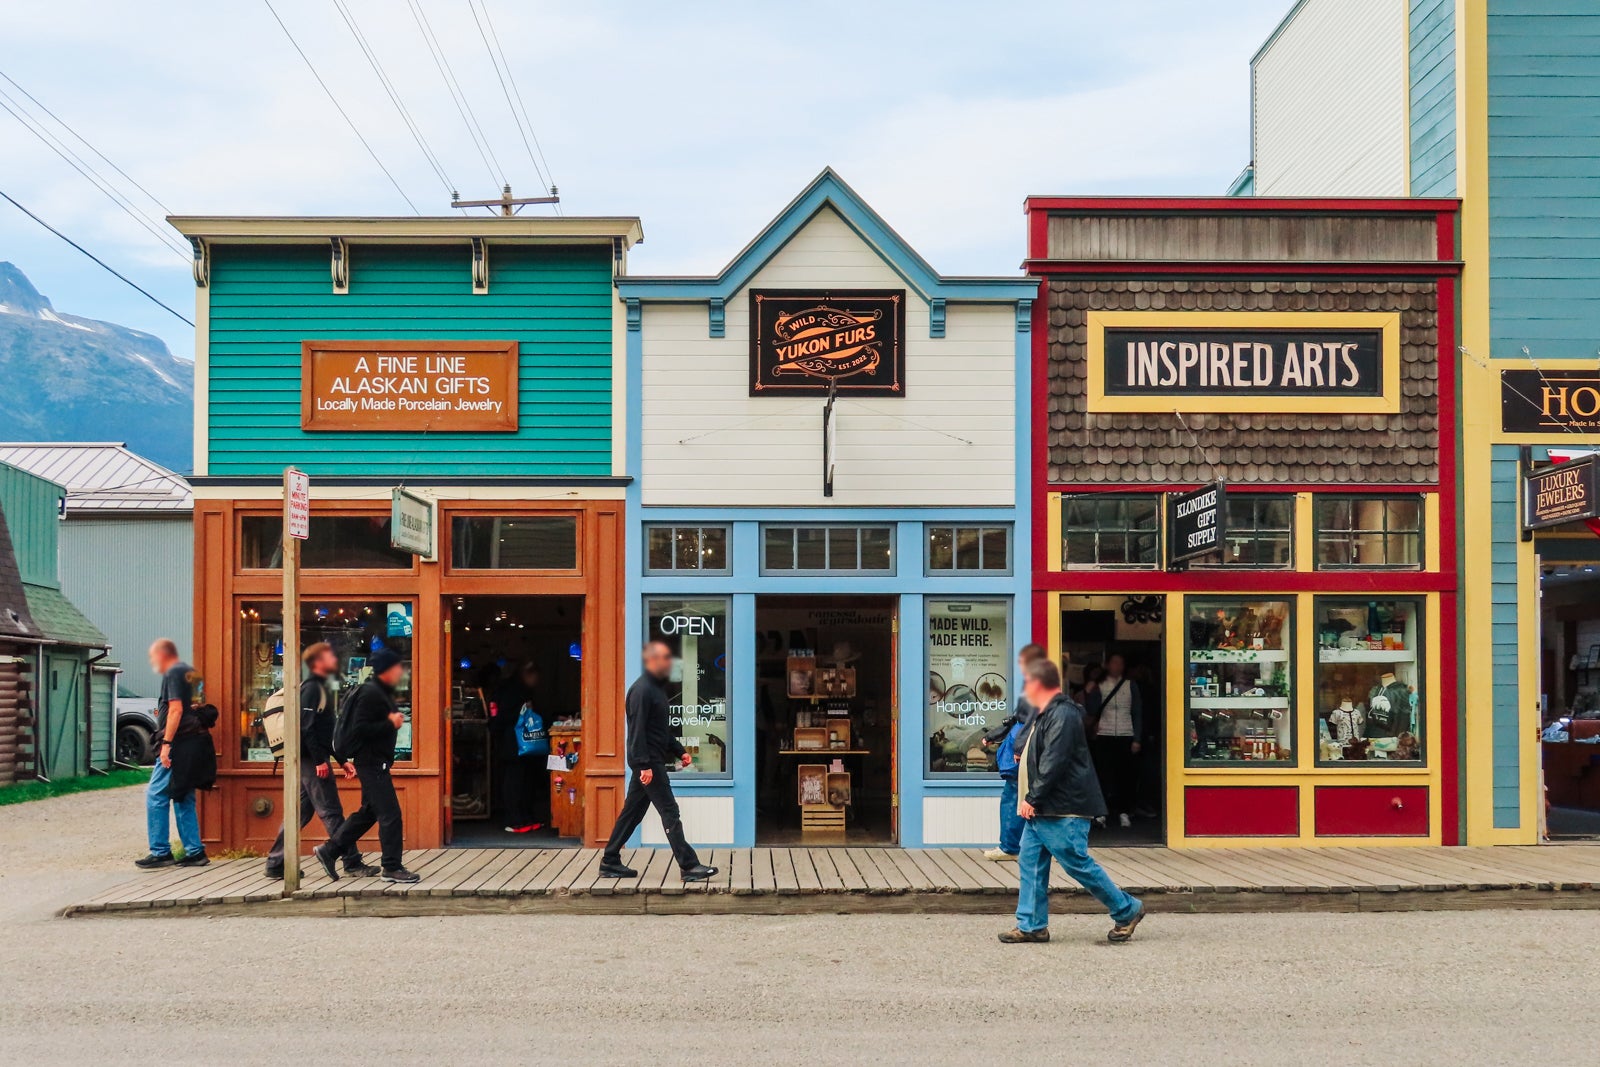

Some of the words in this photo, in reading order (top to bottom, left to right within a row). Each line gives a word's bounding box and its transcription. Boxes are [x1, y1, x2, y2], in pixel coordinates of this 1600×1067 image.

[788, 315, 816, 331] WILD
[775, 336, 830, 362] YUKON
[835, 325, 876, 348] FURS
[354, 357, 370, 374] A
[378, 357, 418, 374] FINE
[425, 357, 466, 374] LINE
[838, 363, 852, 371] EST.
[852, 354, 868, 367] 2022
[1127, 341, 1273, 387] INSPIRED
[1281, 341, 1360, 388] ARTS
[330, 377, 428, 394] ALASKAN
[435, 377, 490, 394] GIFTS
[317, 397, 359, 413] Locally
[361, 398, 396, 411] Made
[398, 397, 451, 411] Porcelain
[454, 398, 502, 413] Jewelry
[1540, 469, 1580, 493] LUXURY
[290, 500, 308, 512] PARKING
[1176, 490, 1217, 519] KLONDIKE
[1536, 483, 1585, 512] JEWELERS
[1197, 508, 1217, 528] GIFT
[1187, 527, 1217, 548] SUPPLY
[660, 616, 715, 636] OPEN
[930, 617, 958, 630] MADE
[960, 618, 992, 631] WILD.
[960, 634, 993, 647] HERE.
[669, 702, 724, 714] rmanent
[936, 698, 1007, 713] Handmade
[958, 713, 986, 726] Hats
